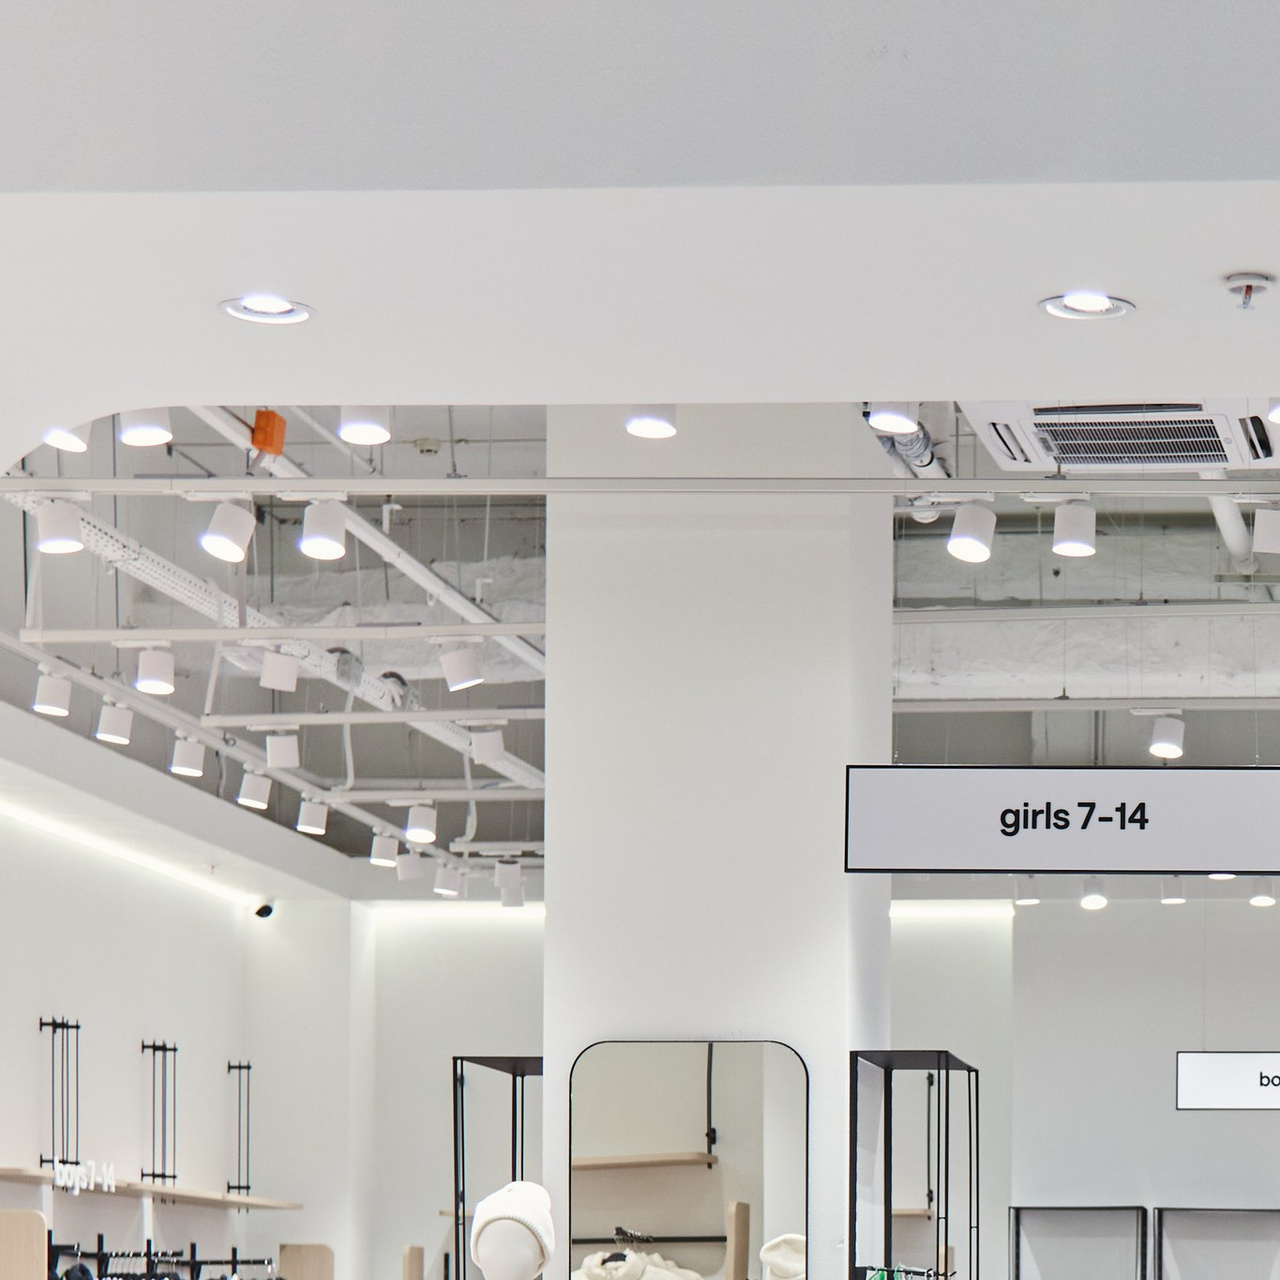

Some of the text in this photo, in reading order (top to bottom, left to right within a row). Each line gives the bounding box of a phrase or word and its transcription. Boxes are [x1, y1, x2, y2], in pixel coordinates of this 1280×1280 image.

[1000, 802, 1149, 837] girls 7-14
[54, 1155, 116, 1196] boys 7-14
